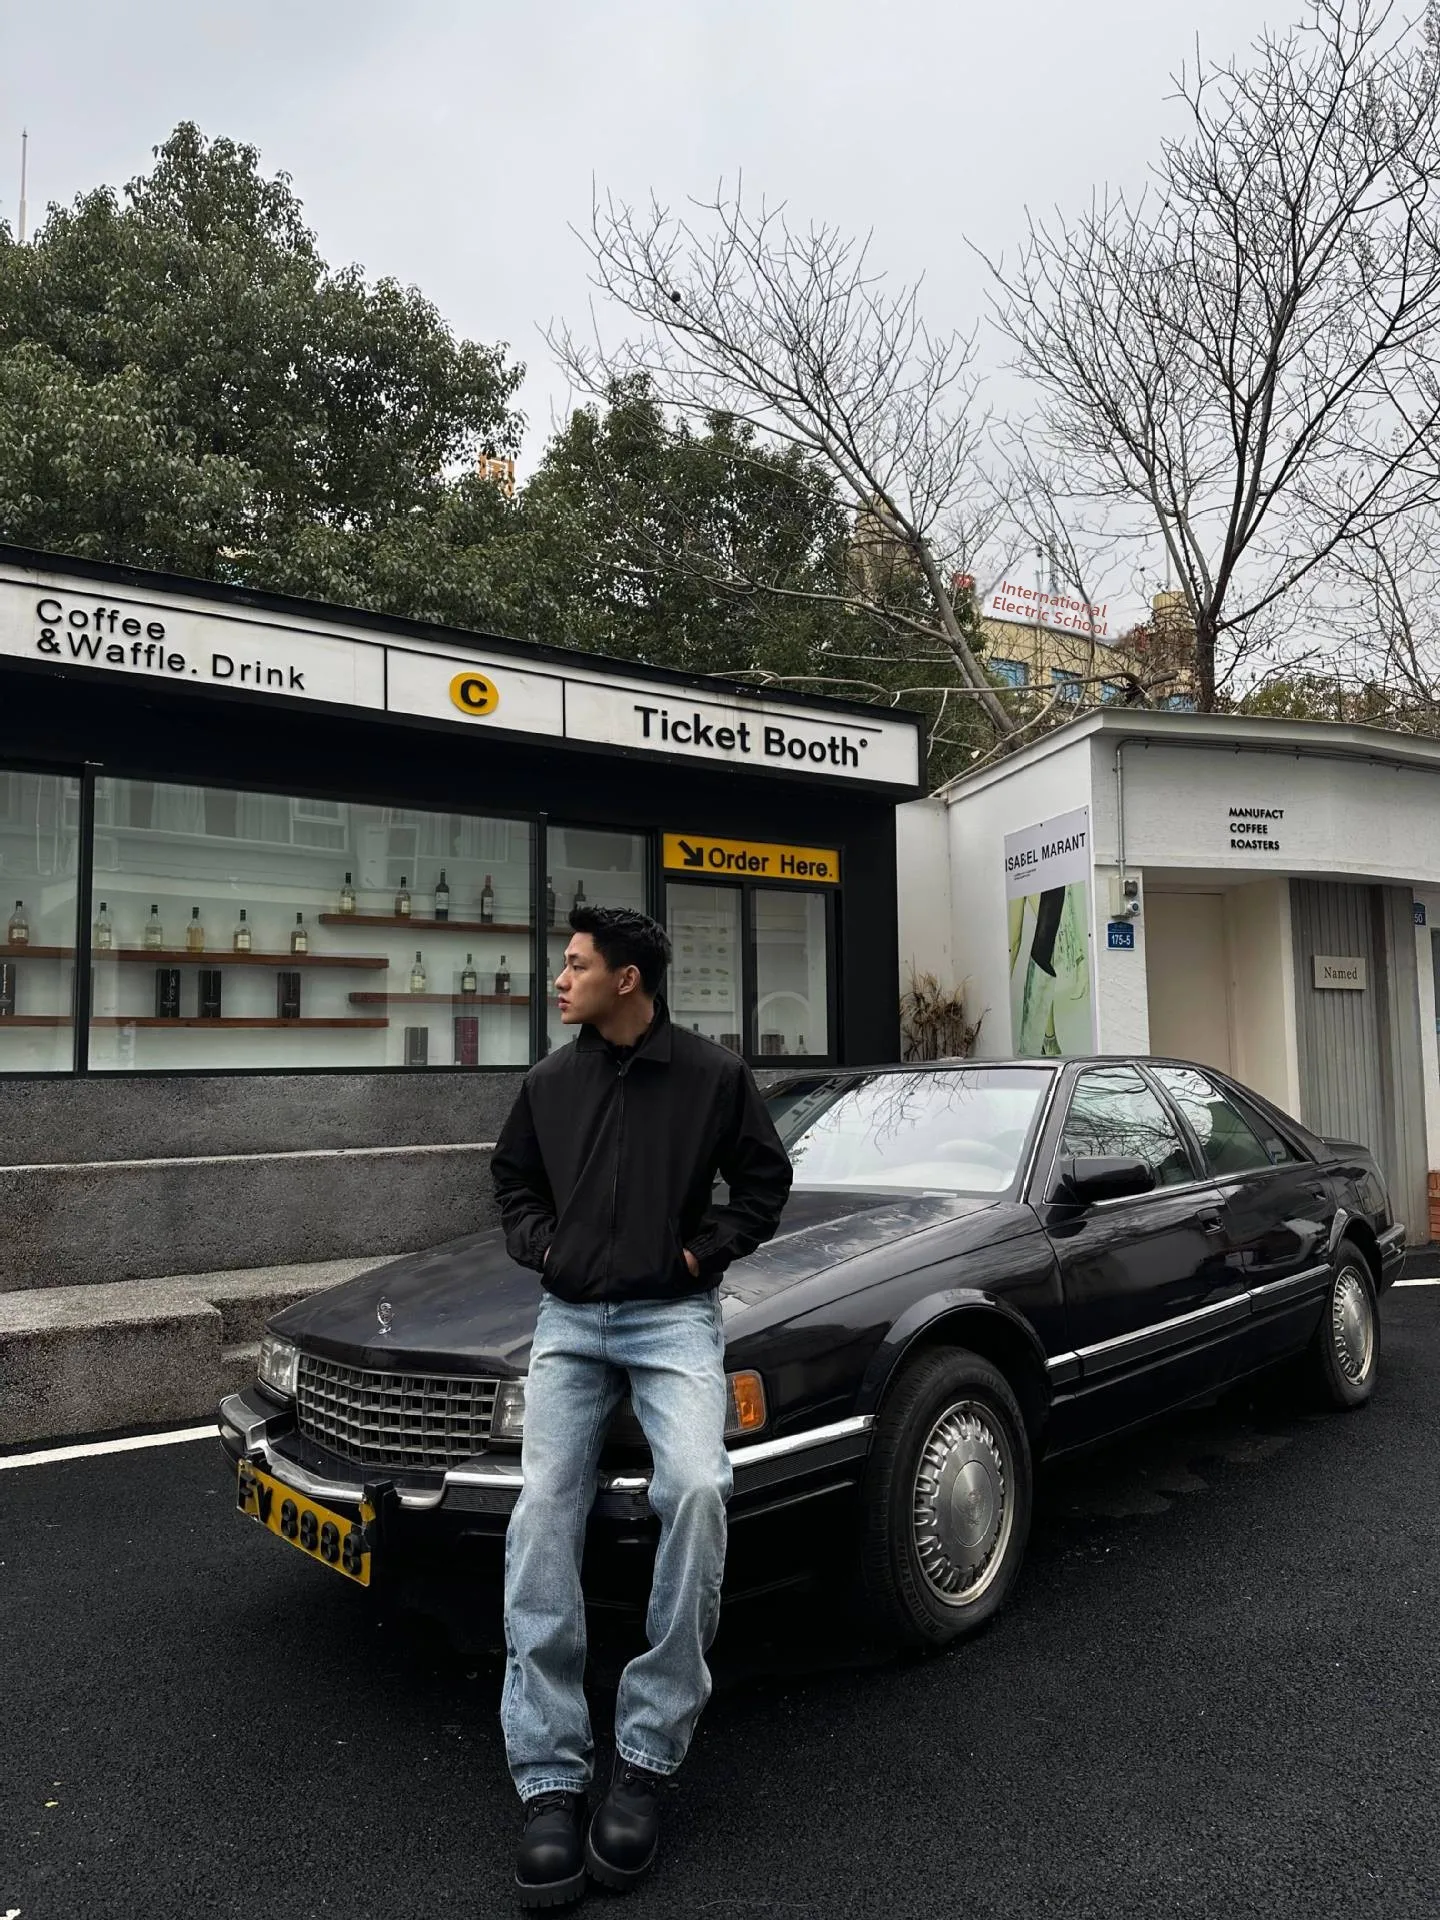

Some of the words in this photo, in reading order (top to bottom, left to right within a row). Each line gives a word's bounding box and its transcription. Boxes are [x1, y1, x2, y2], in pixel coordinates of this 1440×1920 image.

[1001, 580, 1107, 618] International
[36, 598, 166, 640] Coffee
[992, 597, 1050, 622] Electric
[1054, 612, 1107, 635] School
[212, 653, 306, 691] Drink
[460, 679, 488, 708] C
[633, 704, 751, 753] Ticket
[1229, 807, 1285, 819] MANUFACT
[1230, 822, 1268, 834] COFFEE
[1005, 849, 1039, 872] ISABEL
[1041, 832, 1086, 860] MARANT
[1230, 839, 1280, 851] ROASTERS
[708, 846, 770, 874] Order
[781, 853, 834, 879] Here.
[1111, 934, 1131, 945] 175-5
[1323, 966, 1358, 980] Named
